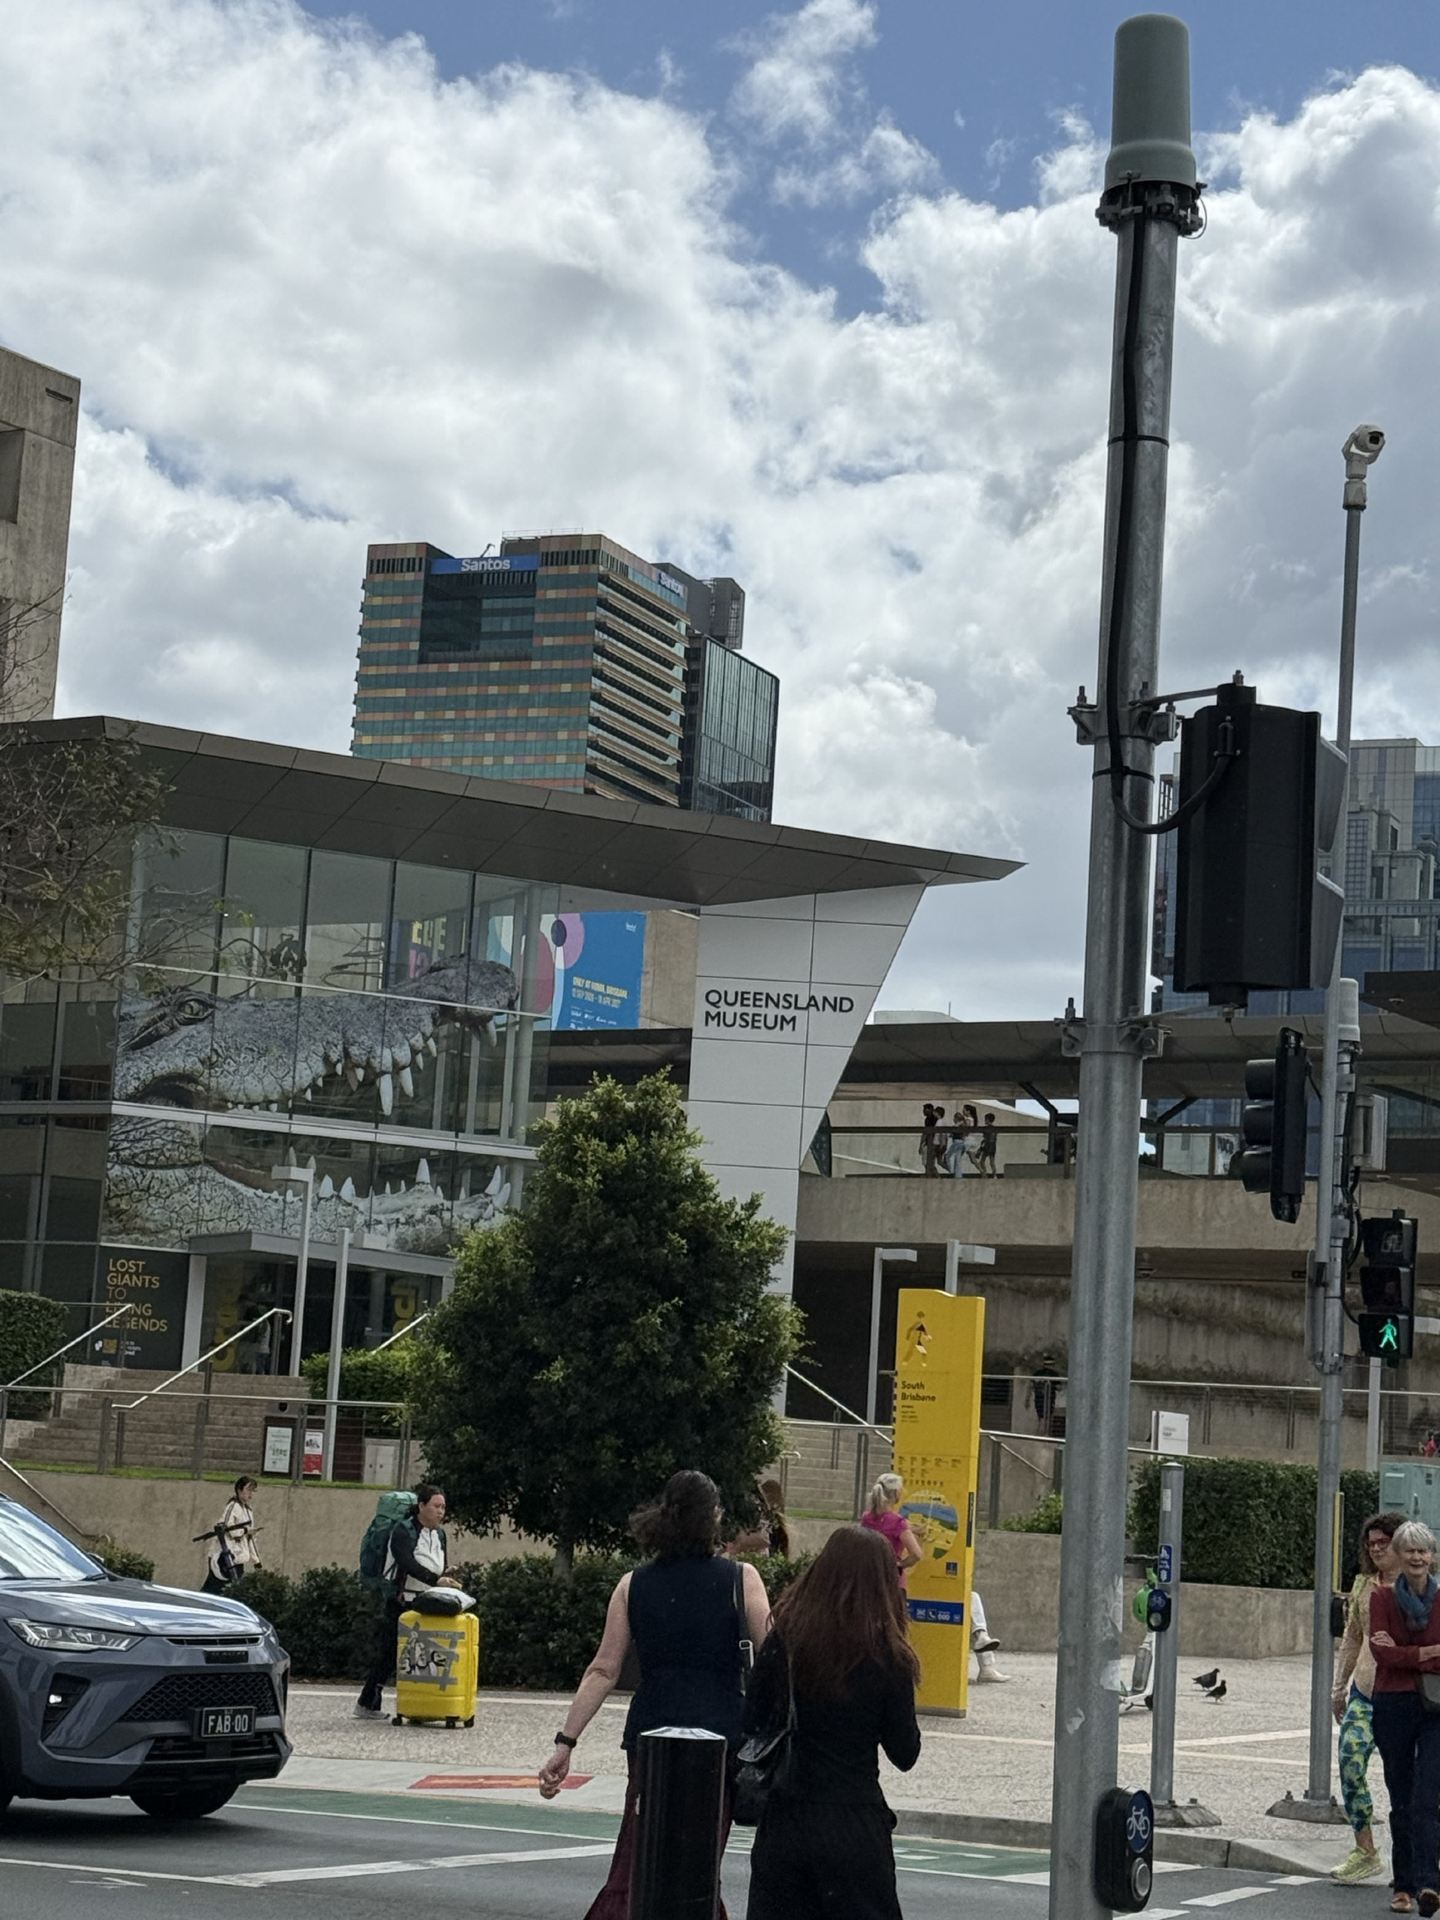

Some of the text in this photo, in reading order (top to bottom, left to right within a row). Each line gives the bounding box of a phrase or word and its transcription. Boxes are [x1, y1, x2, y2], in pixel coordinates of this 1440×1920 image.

[461, 558, 511, 572] Santos
[704, 989, 854, 1013] QUEENSLAND
[704, 1011, 797, 1032] MUSEUM
[109, 1258, 146, 1273] LOST
[107, 1273, 160, 1288] GIANTS
[106, 1286, 126, 1300] TO
[105, 1301, 152, 1316] LIING
[901, 1381, 925, 1390] South
[901, 1392, 936, 1402] Brisbane
